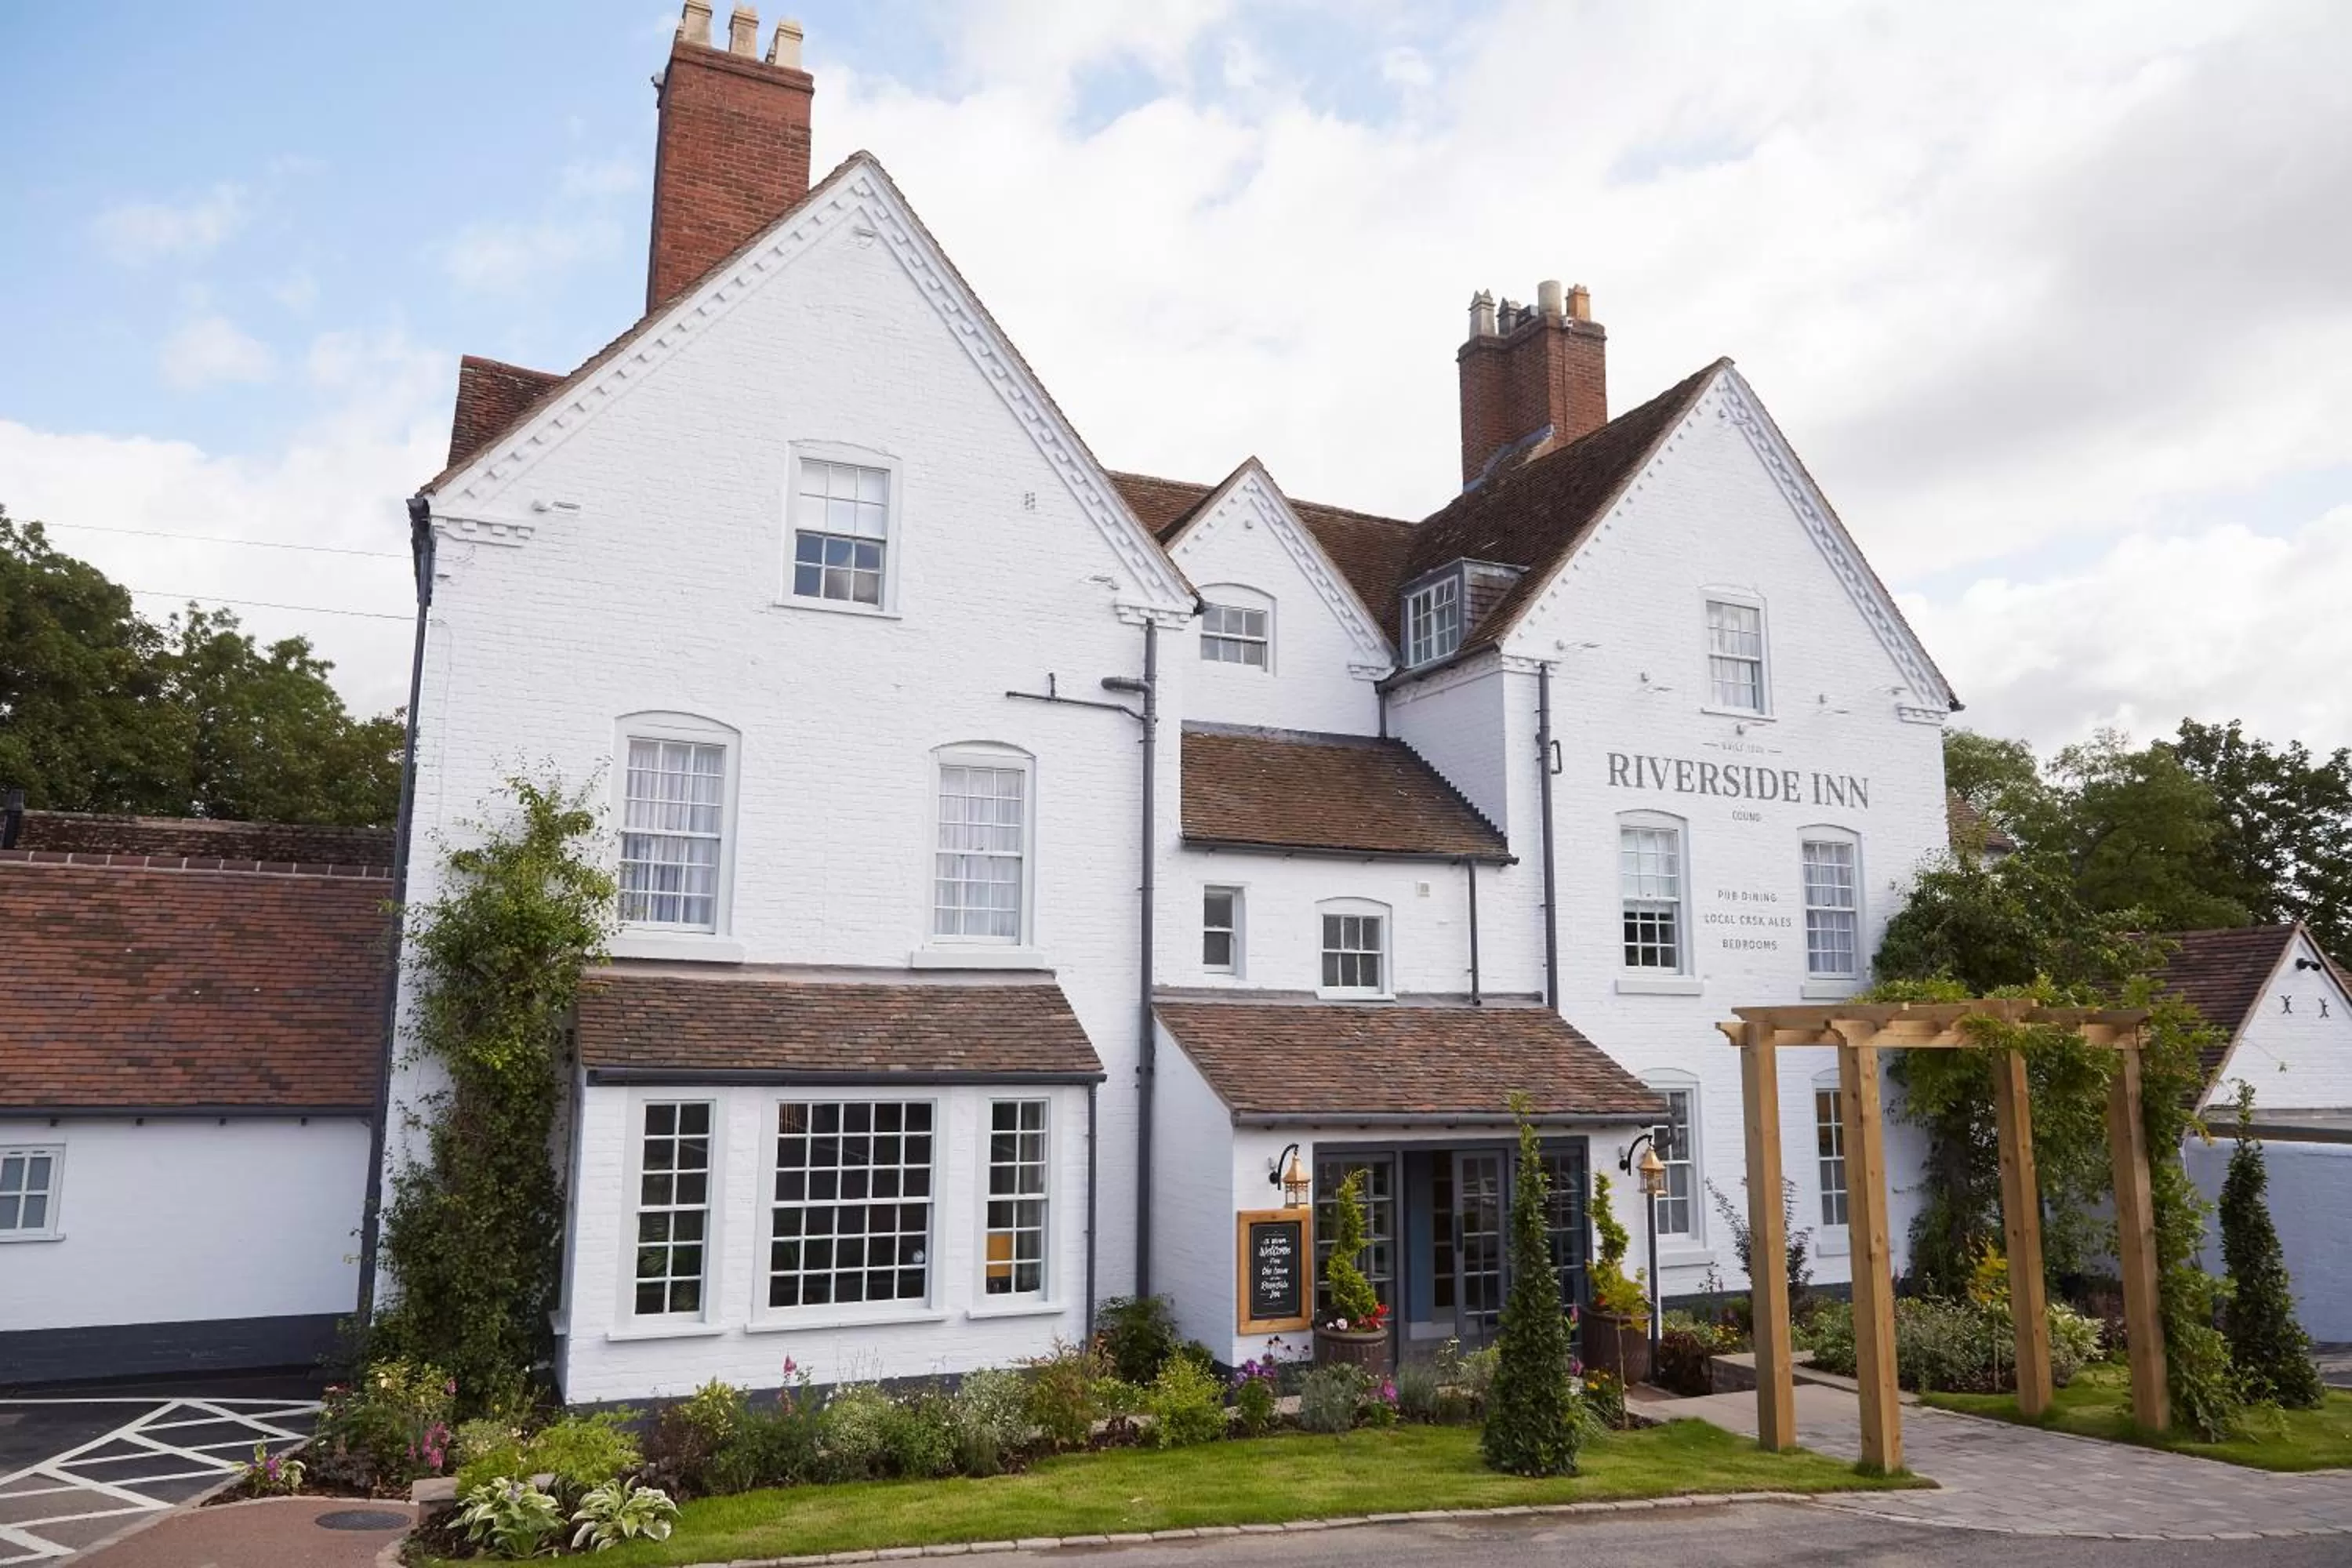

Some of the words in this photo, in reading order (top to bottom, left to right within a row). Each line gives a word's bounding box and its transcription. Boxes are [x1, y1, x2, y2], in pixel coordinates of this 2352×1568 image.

[1607, 752, 1801, 804] RIVERSIDE
[1811, 771, 1869, 810] INN
[1718, 890, 1737, 901] PUB
[1741, 891, 1777, 902] DINING
[1705, 913, 1736, 924] LOCAL
[1740, 915, 1765, 926] CASK
[1769, 916, 1791, 927] ALES
[1722, 938, 1777, 950] BEDROOMS
